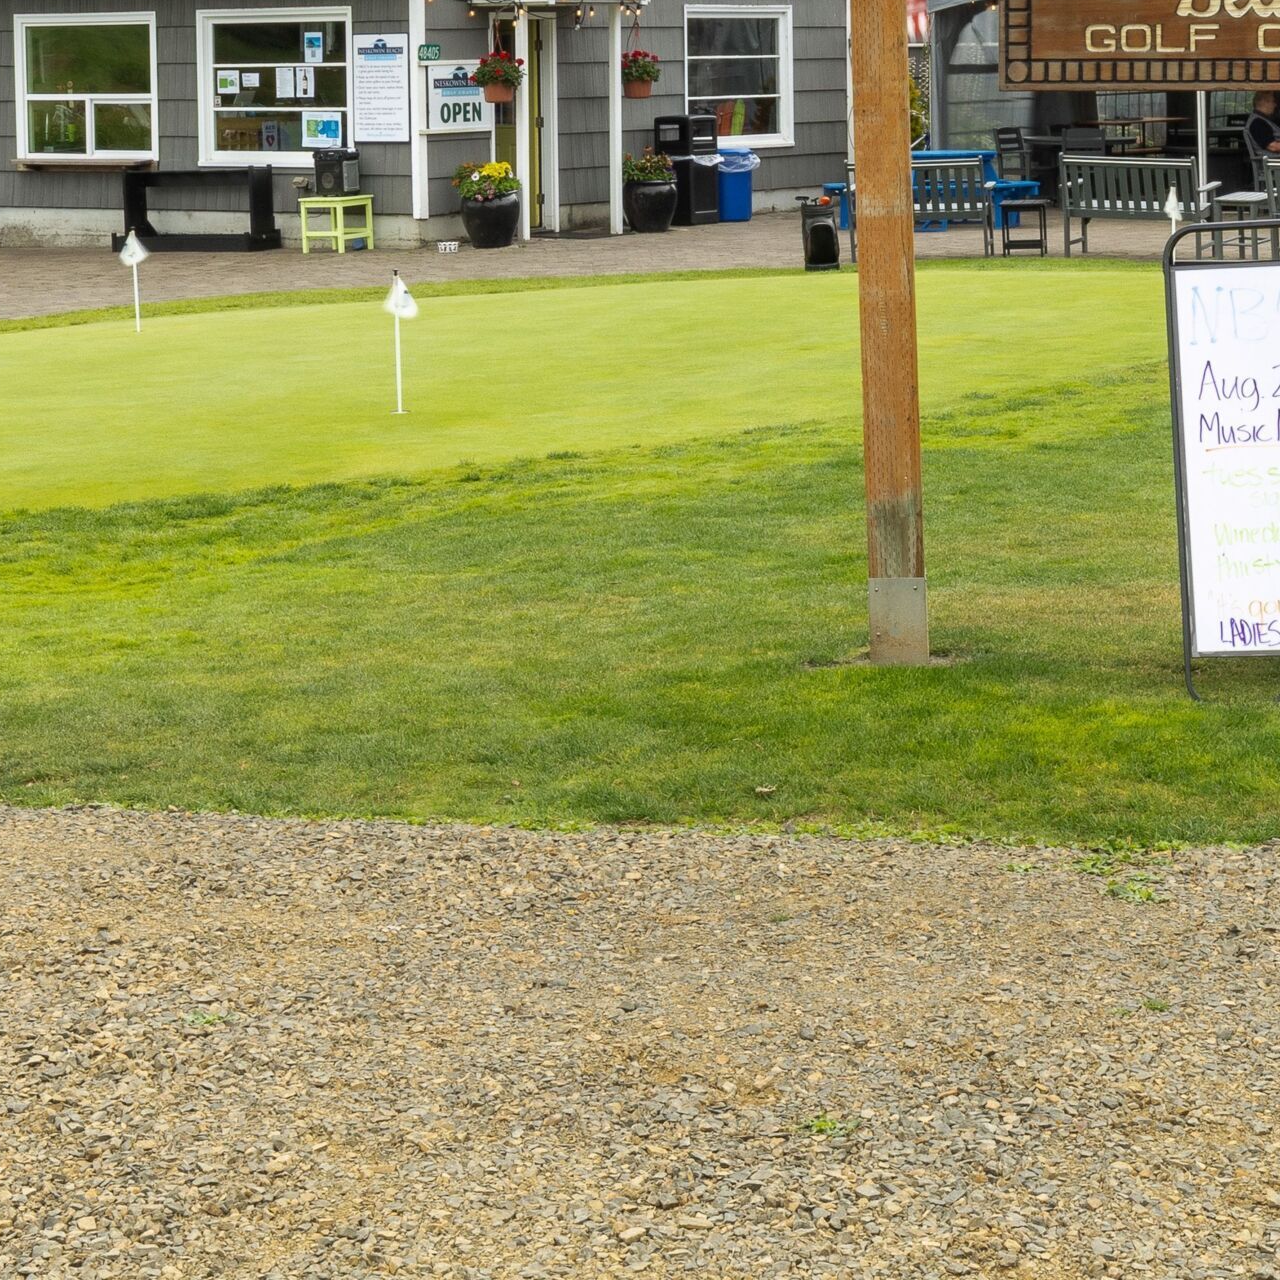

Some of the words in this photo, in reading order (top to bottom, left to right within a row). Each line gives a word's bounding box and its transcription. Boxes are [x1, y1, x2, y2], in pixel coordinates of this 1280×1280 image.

[1084, 23, 1220, 53] GOLF
[419, 46, 440, 60] 48405
[434, 79, 466, 88] NESKOWIN
[440, 102, 482, 124] OPEN
[1199, 360, 1265, 412] Aug.
[1199, 411, 1271, 445] Music
